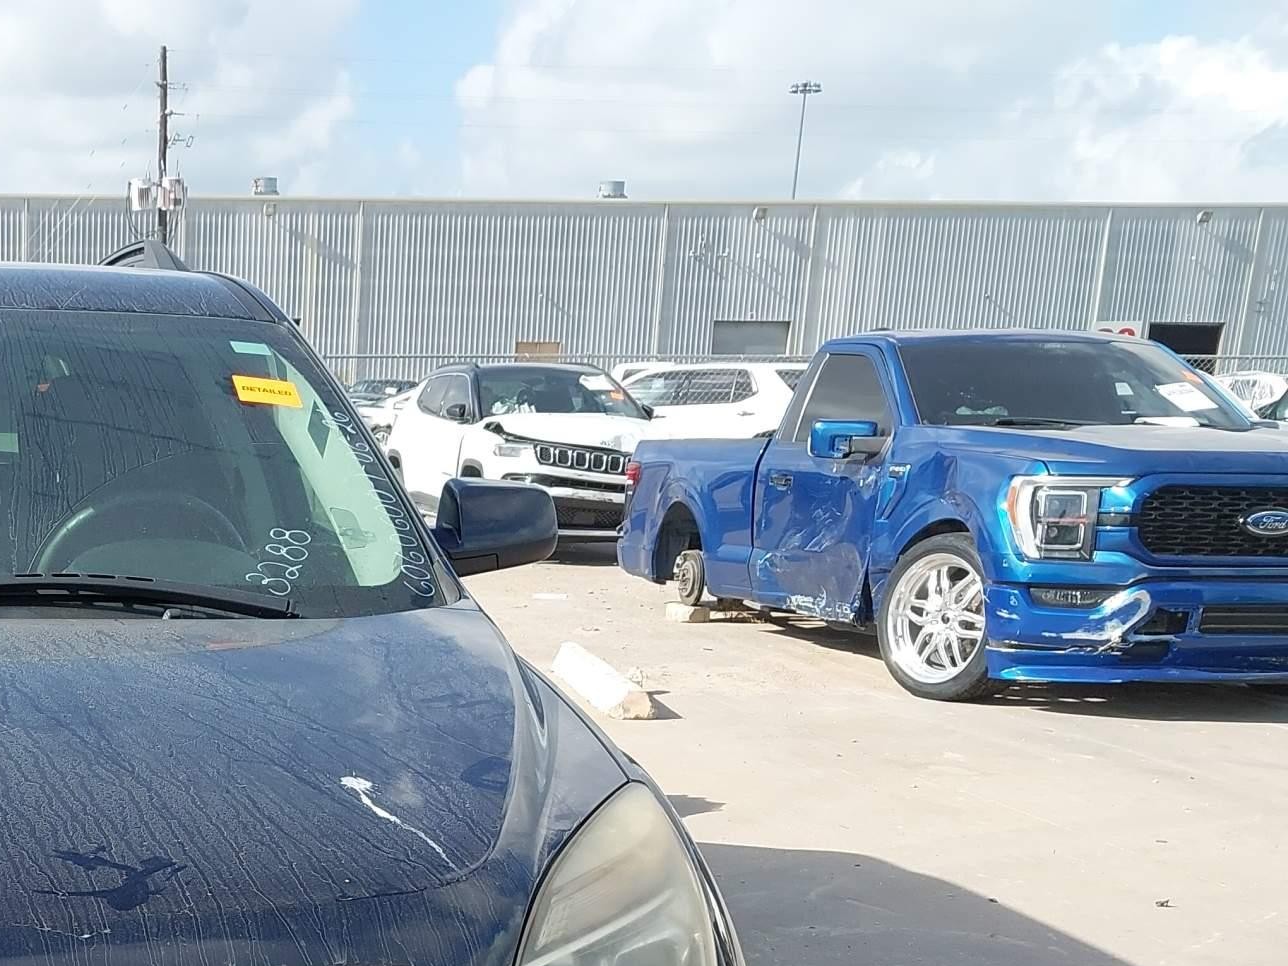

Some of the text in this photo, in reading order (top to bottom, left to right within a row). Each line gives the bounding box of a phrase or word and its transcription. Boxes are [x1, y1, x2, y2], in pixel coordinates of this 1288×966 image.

[241, 385, 292, 397] DETAILED
[1259, 515, 1288, 529] Ford
[245, 527, 312, 596] 3288
